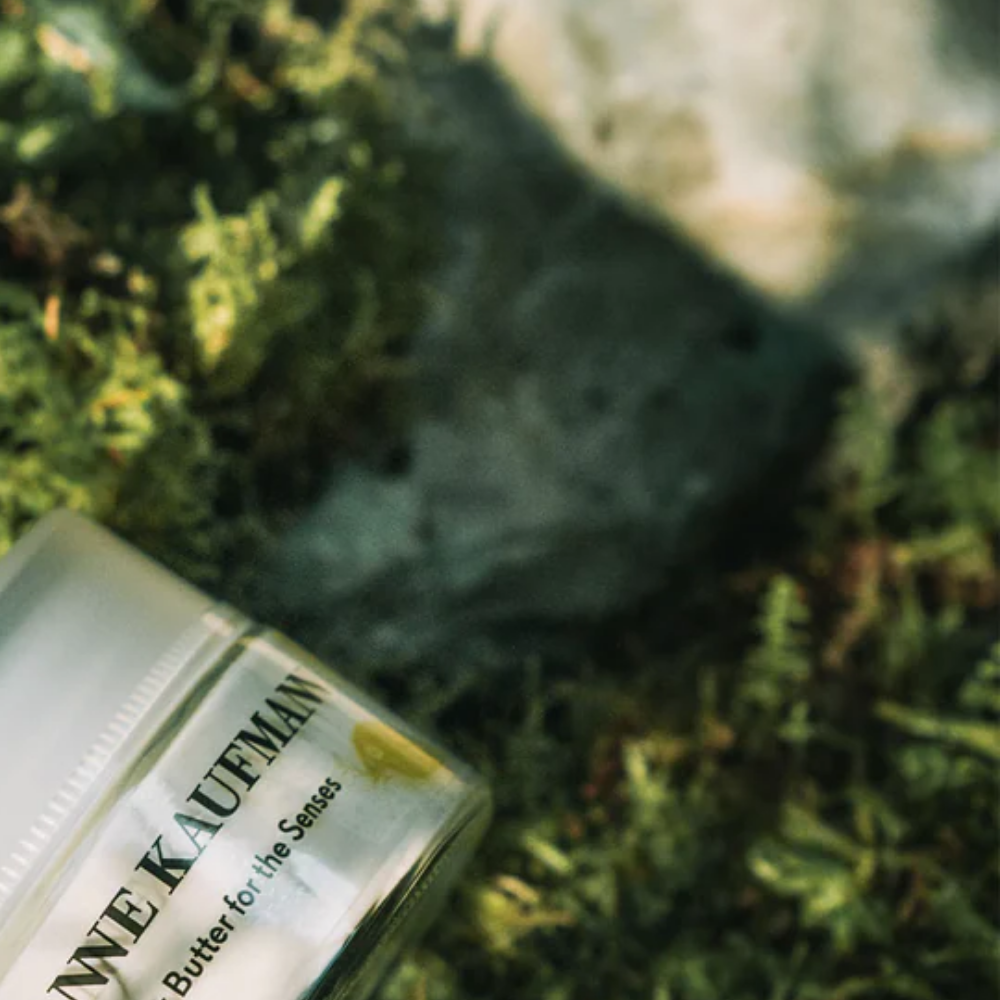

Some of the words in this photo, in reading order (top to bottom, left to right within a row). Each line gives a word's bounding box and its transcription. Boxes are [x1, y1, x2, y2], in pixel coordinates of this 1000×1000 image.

[162, 915, 235, 997] Butter
[223, 881, 262, 916] for
[254, 841, 291, 879] the
[278, 776, 342, 842] Senses
